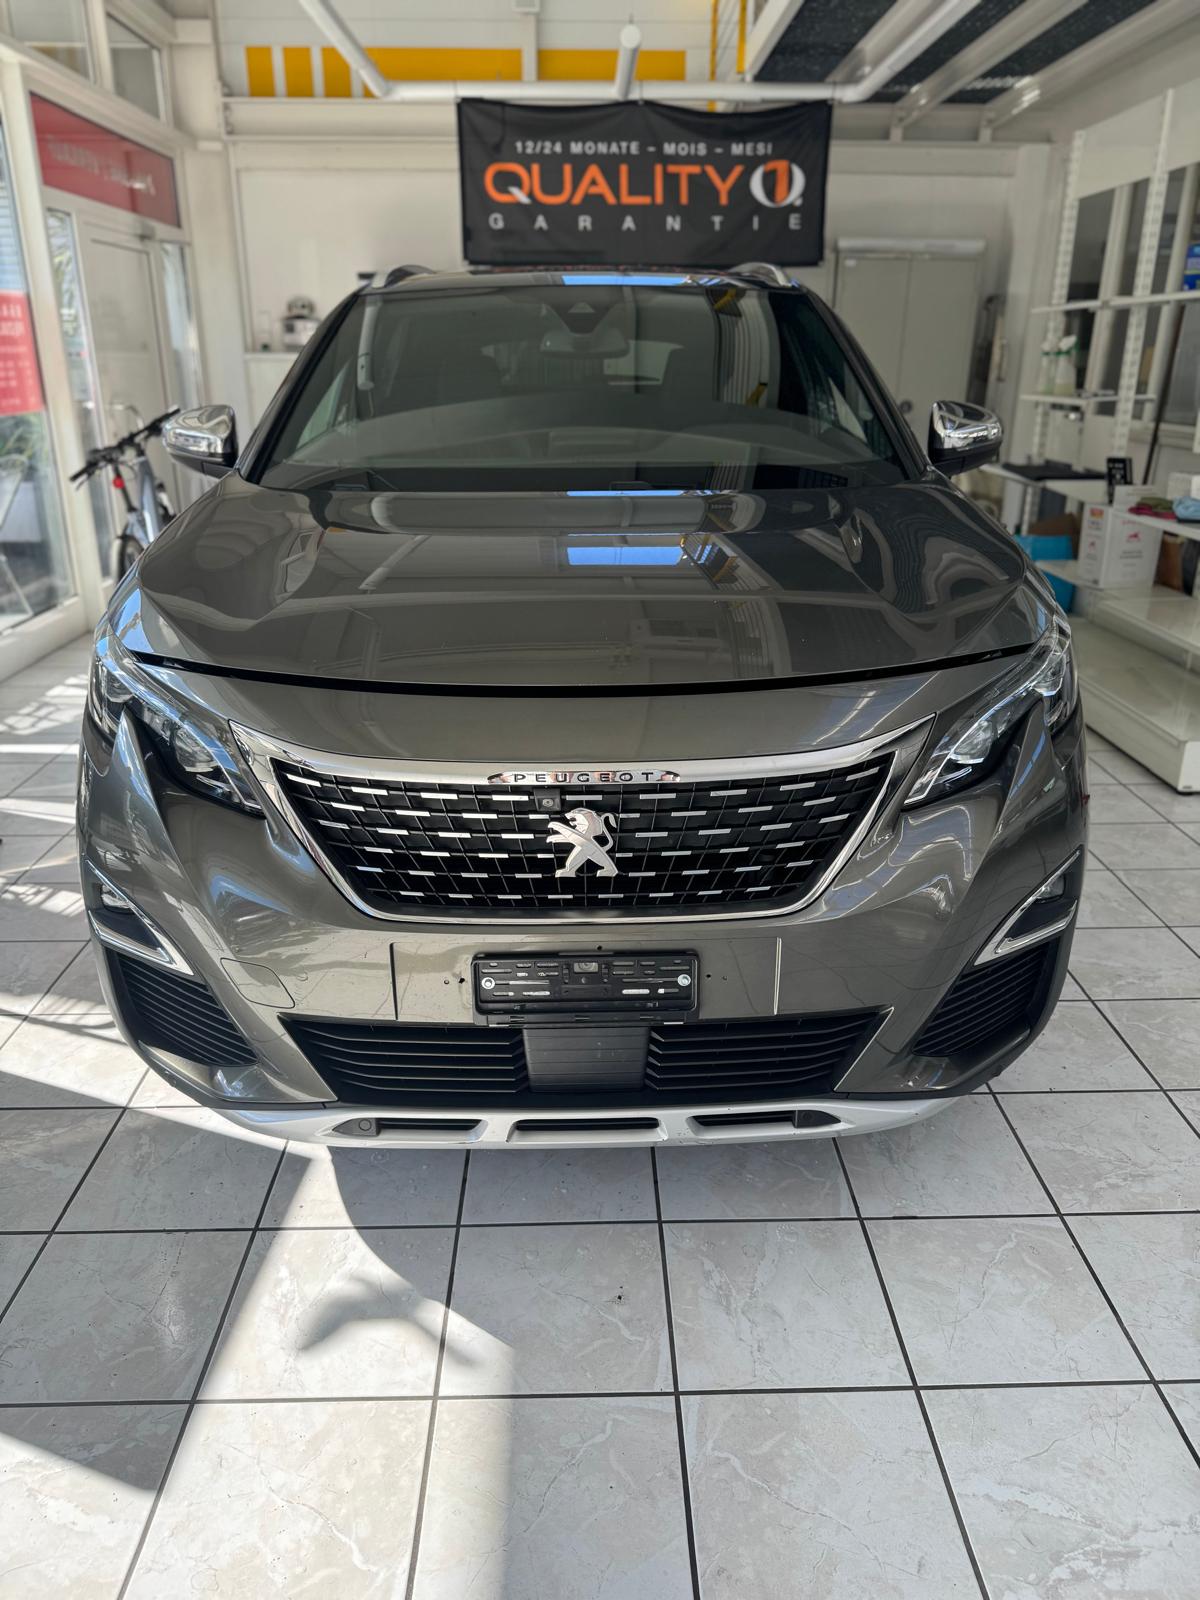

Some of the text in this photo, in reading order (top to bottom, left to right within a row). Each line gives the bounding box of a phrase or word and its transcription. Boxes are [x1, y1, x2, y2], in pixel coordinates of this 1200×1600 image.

[515, 141, 563, 155] 12/24
[570, 141, 640, 155] MONATE
[663, 142, 707, 156] MOIS
[731, 142, 773, 156] MESI
[484, 162, 745, 206] QUALITY
[489, 213, 802, 231] GARANTIE
[514, 772, 654, 783] PEUGEOT
